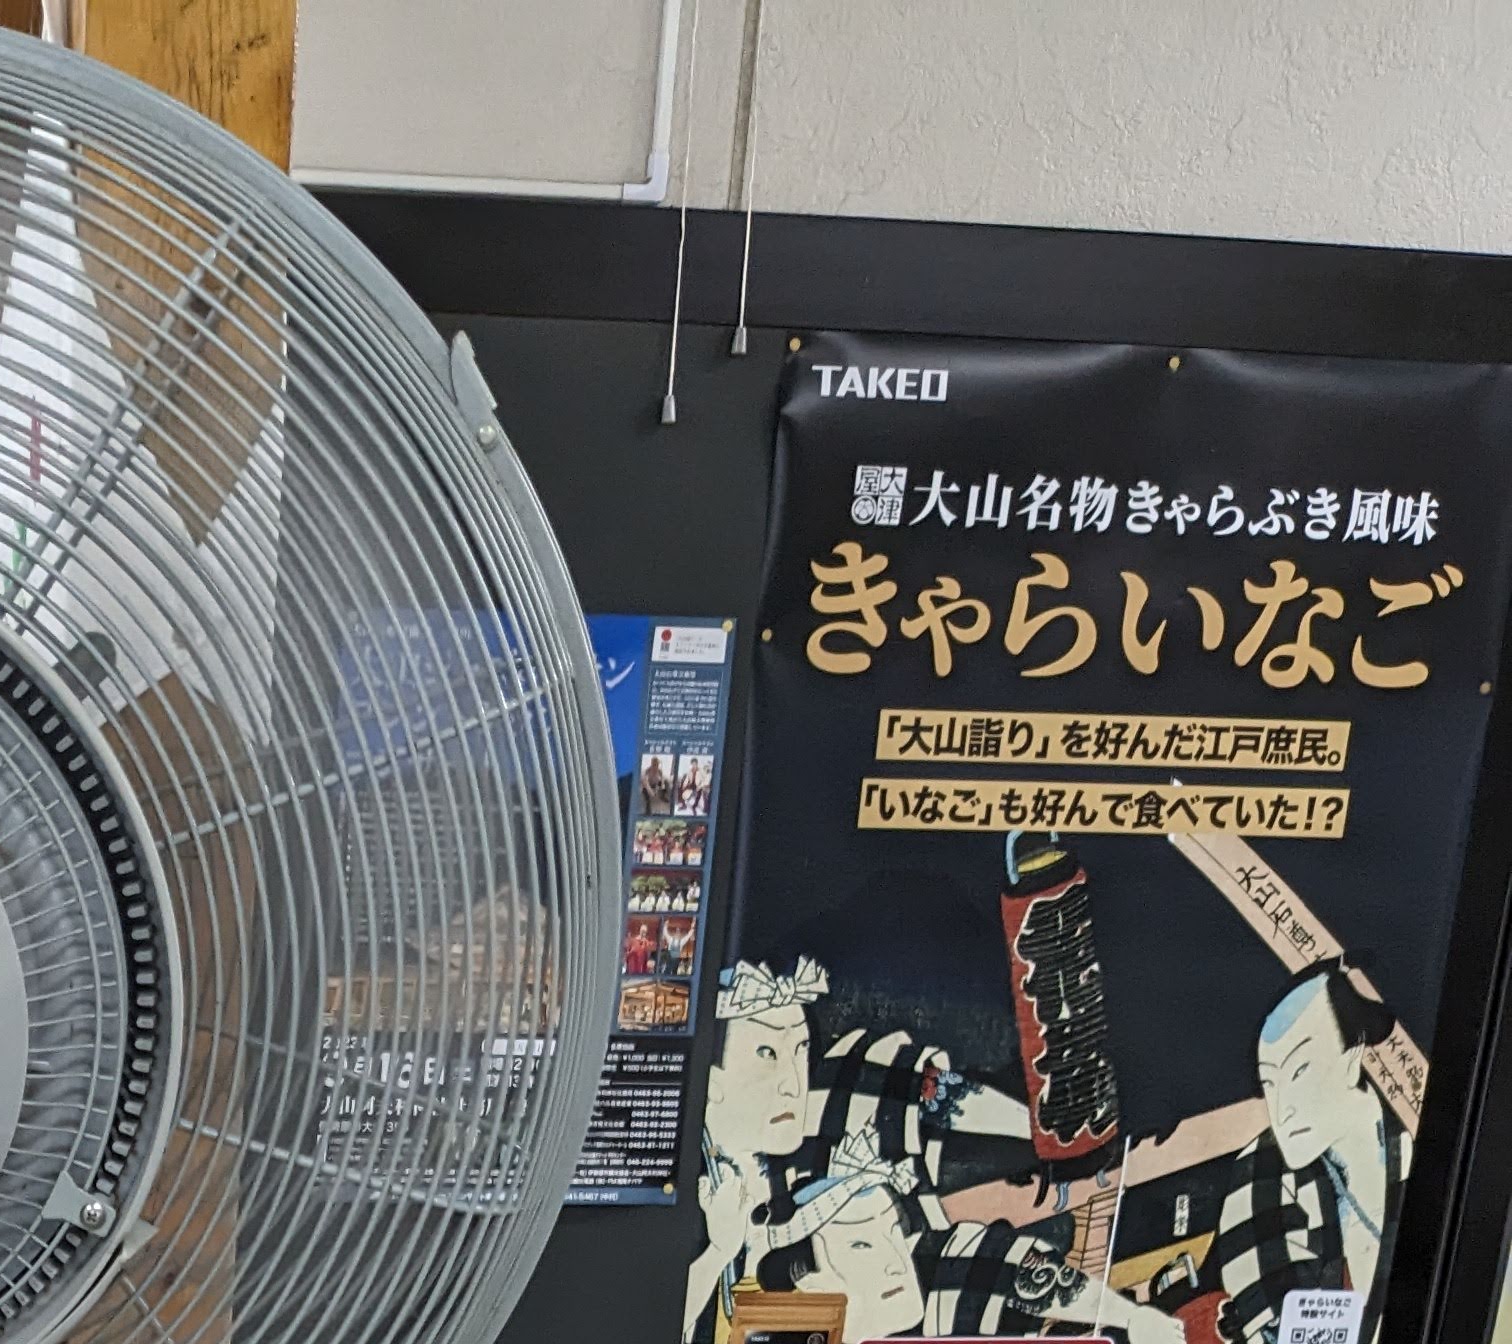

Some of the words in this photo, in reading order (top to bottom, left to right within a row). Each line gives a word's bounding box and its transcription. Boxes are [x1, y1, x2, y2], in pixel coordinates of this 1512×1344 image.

[811, 364, 949, 402] TAKEO
[908, 469, 1440, 546] 大山名物きゃらぶき風味
[806, 541, 1465, 689] きゃらいなご
[886, 714, 1341, 767] 「大山詣り」を好んだ江戸庶民。
